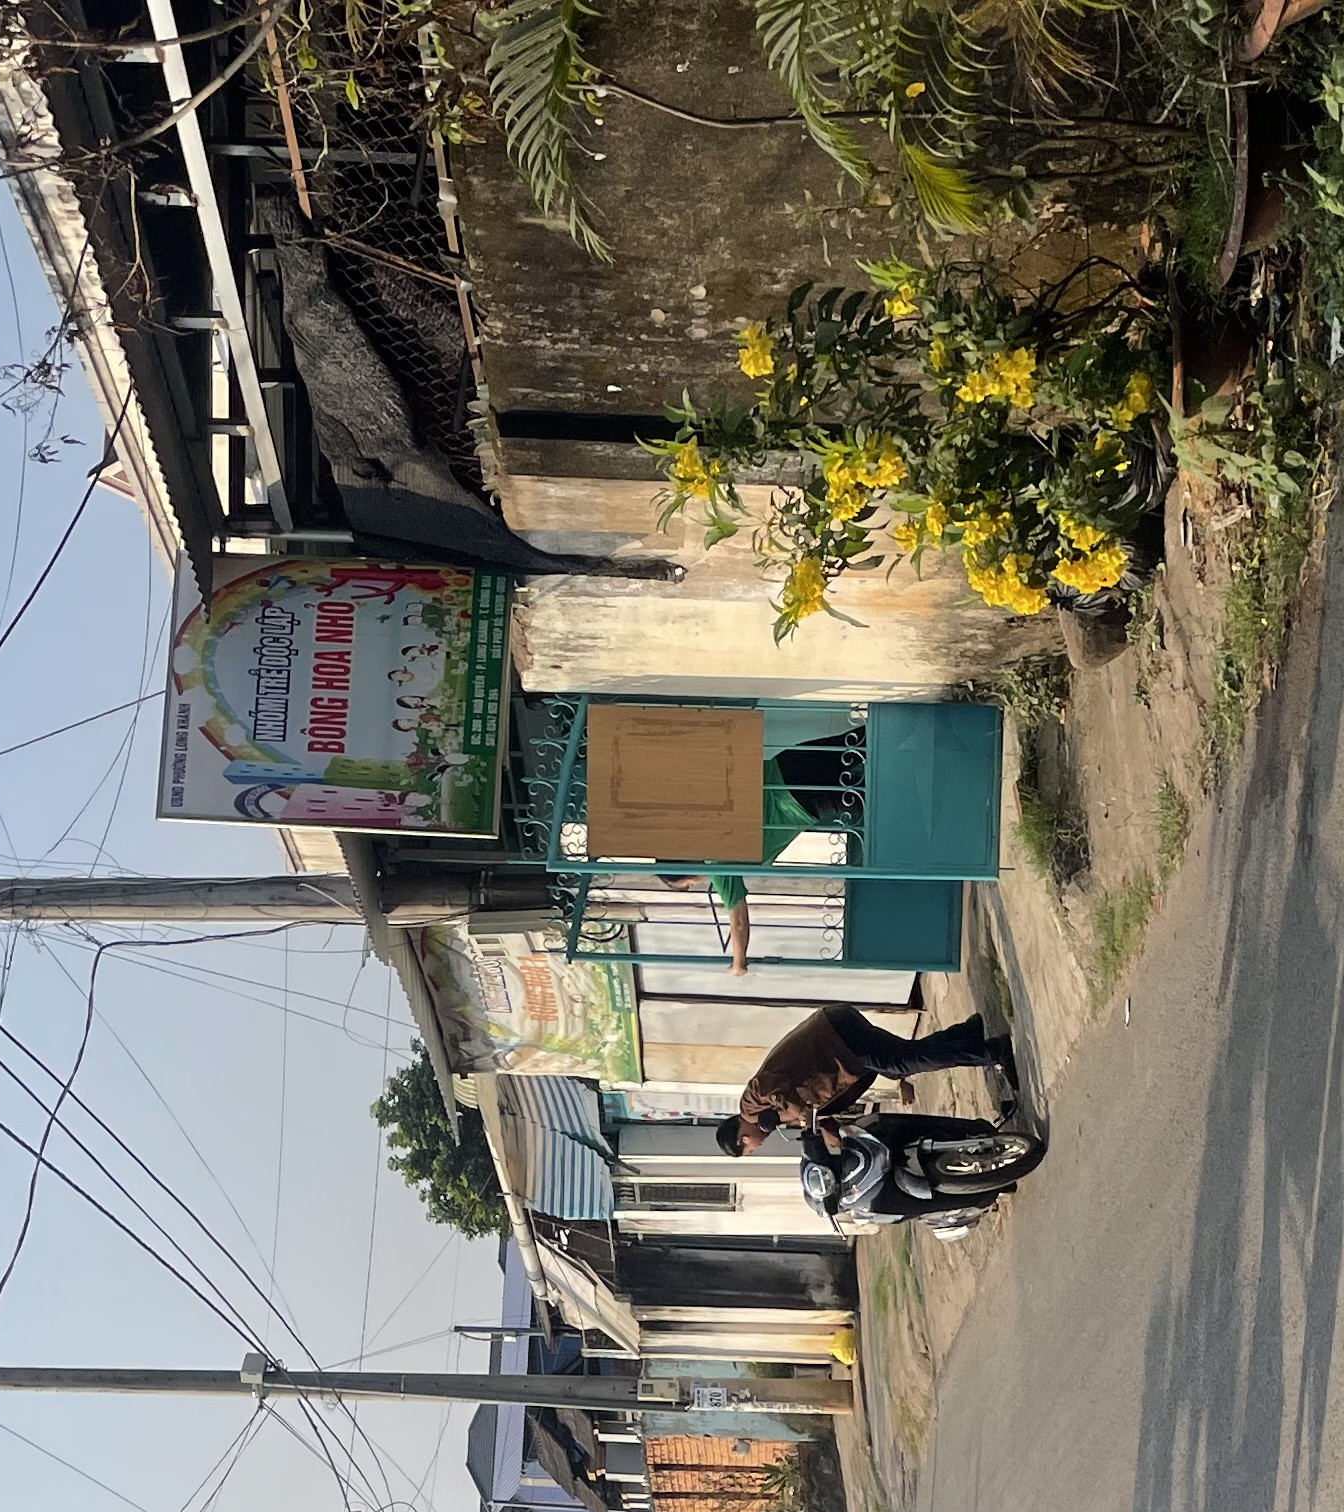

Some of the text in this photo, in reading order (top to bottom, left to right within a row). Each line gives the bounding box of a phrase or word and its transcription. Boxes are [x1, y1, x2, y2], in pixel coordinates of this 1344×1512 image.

[254, 605, 301, 635] LẬP
[299, 600, 355, 753] BÔNG HOA NHỎ
[175, 703, 191, 729] KHÁNH
[248, 696, 288, 742] NHÓM
[175, 731, 189, 752] LONG
